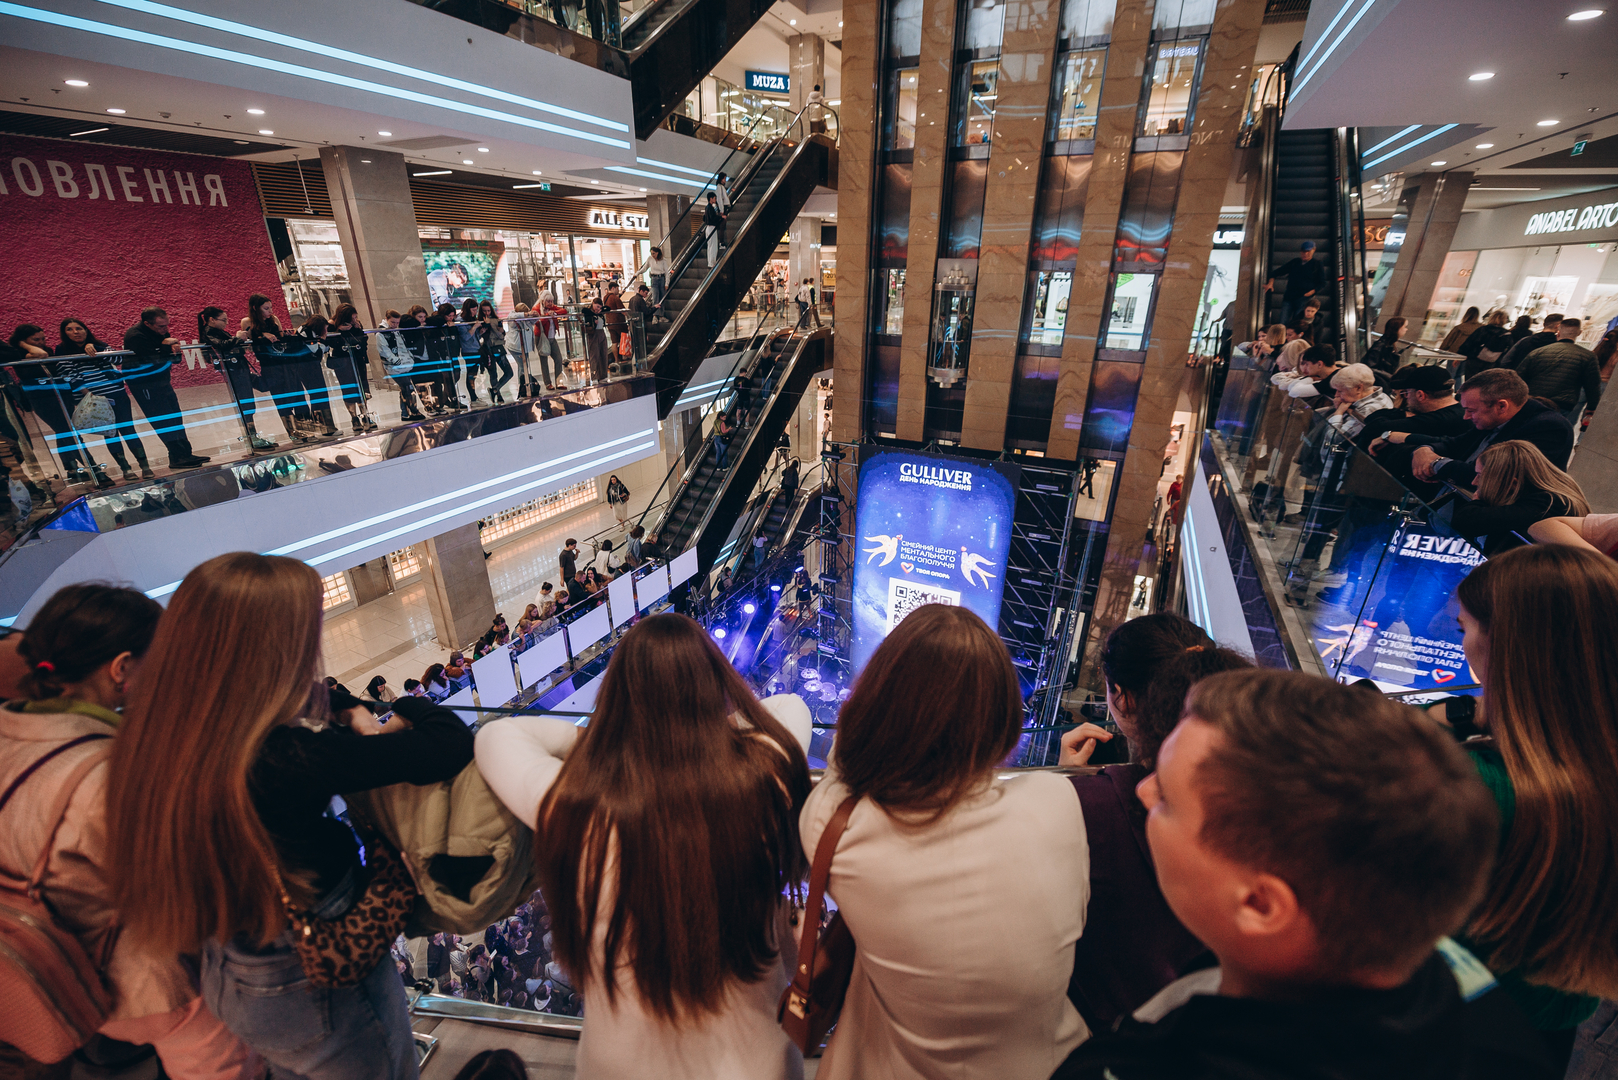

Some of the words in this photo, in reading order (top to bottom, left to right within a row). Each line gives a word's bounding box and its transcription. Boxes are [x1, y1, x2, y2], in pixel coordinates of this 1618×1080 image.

[753, 75, 784, 90] MUZA
[592, 211, 622, 227] ALL
[1524, 208, 1579, 236] ANABEL
[899, 462, 972, 485] GULLIVER
[899, 474, 919, 484] ДЕНЬ
[919, 477, 972, 492] НАРОДЖЕННЯ
[900, 546, 956, 563] МЕНТАЛЬНОГО
[901, 540, 935, 552] СІМЕЙНИЙ
[934, 546, 957, 556] ЦЕНТР
[900, 553, 955, 570] БЛАГОПОЛУЧЧЯ
